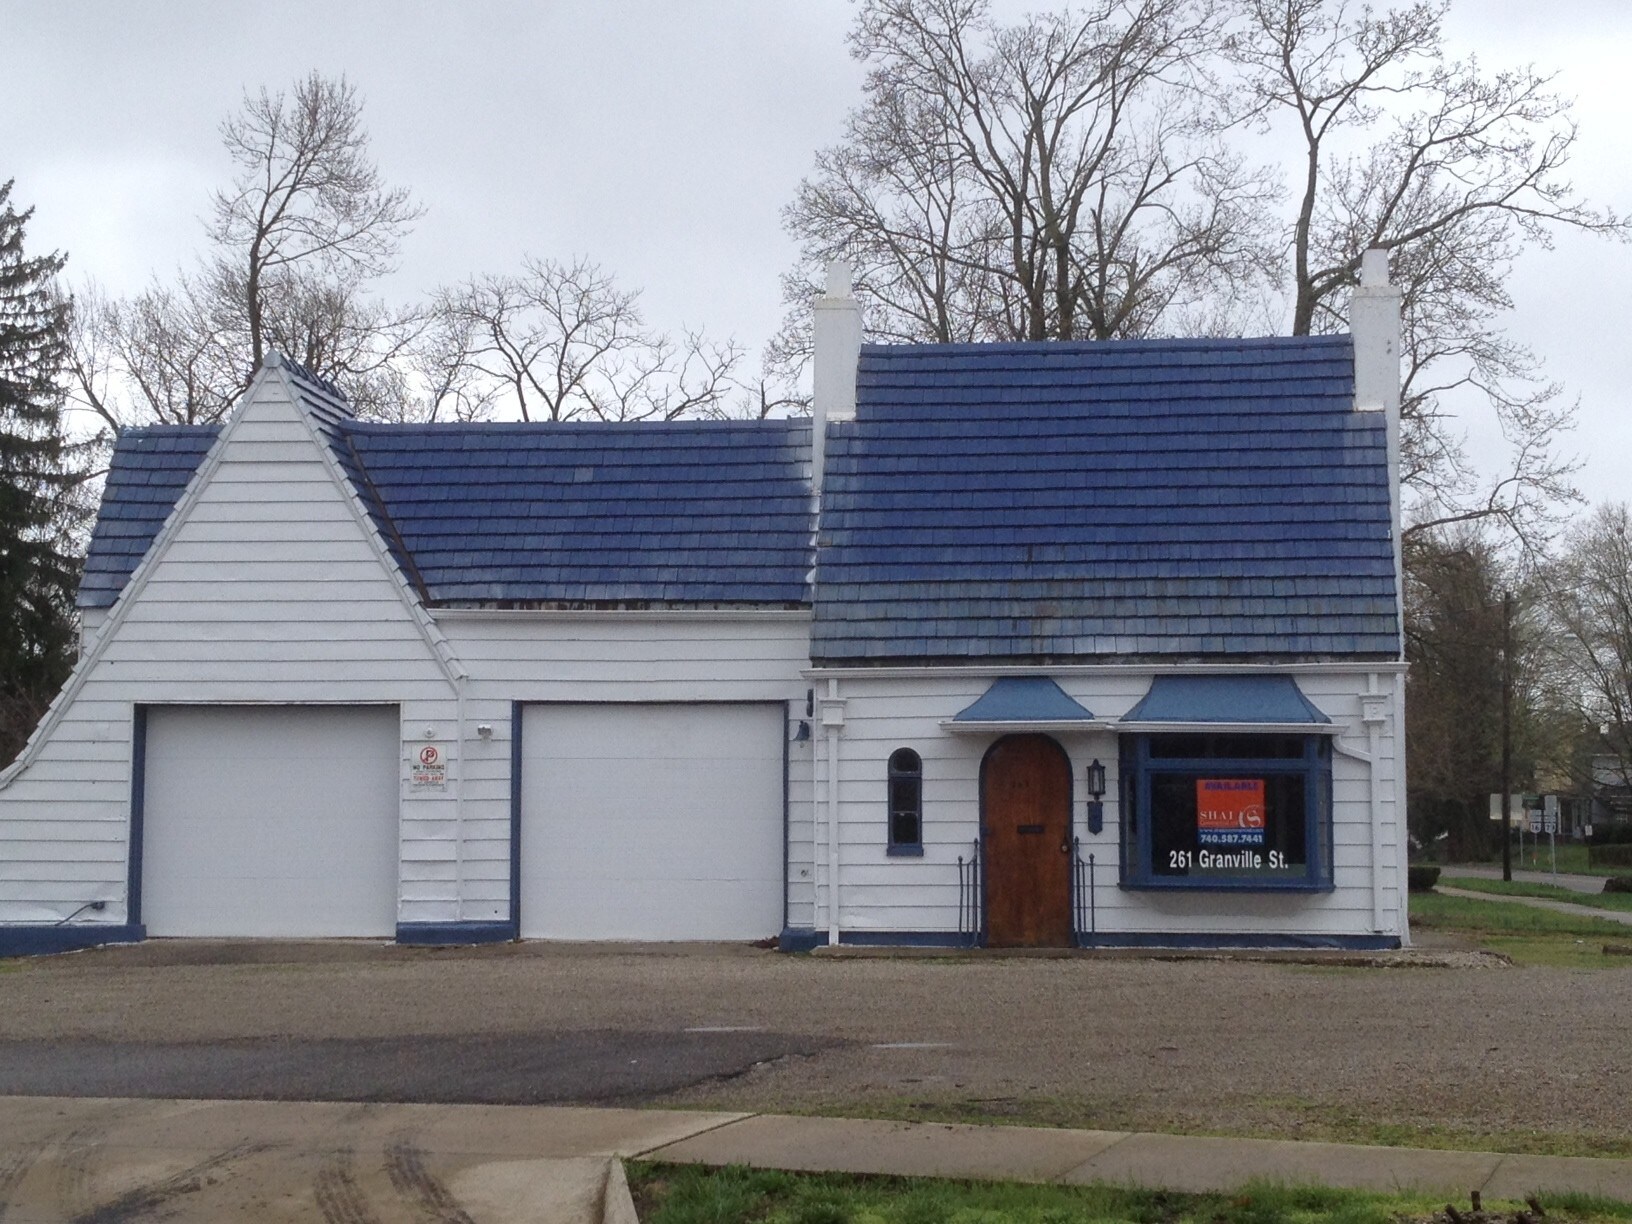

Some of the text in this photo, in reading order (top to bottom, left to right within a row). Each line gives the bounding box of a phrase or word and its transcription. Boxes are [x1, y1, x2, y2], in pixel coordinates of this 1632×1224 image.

[1200, 834, 1263, 843] 740.587.7441
[1169, 850, 1289, 868] 261 Granville St.
